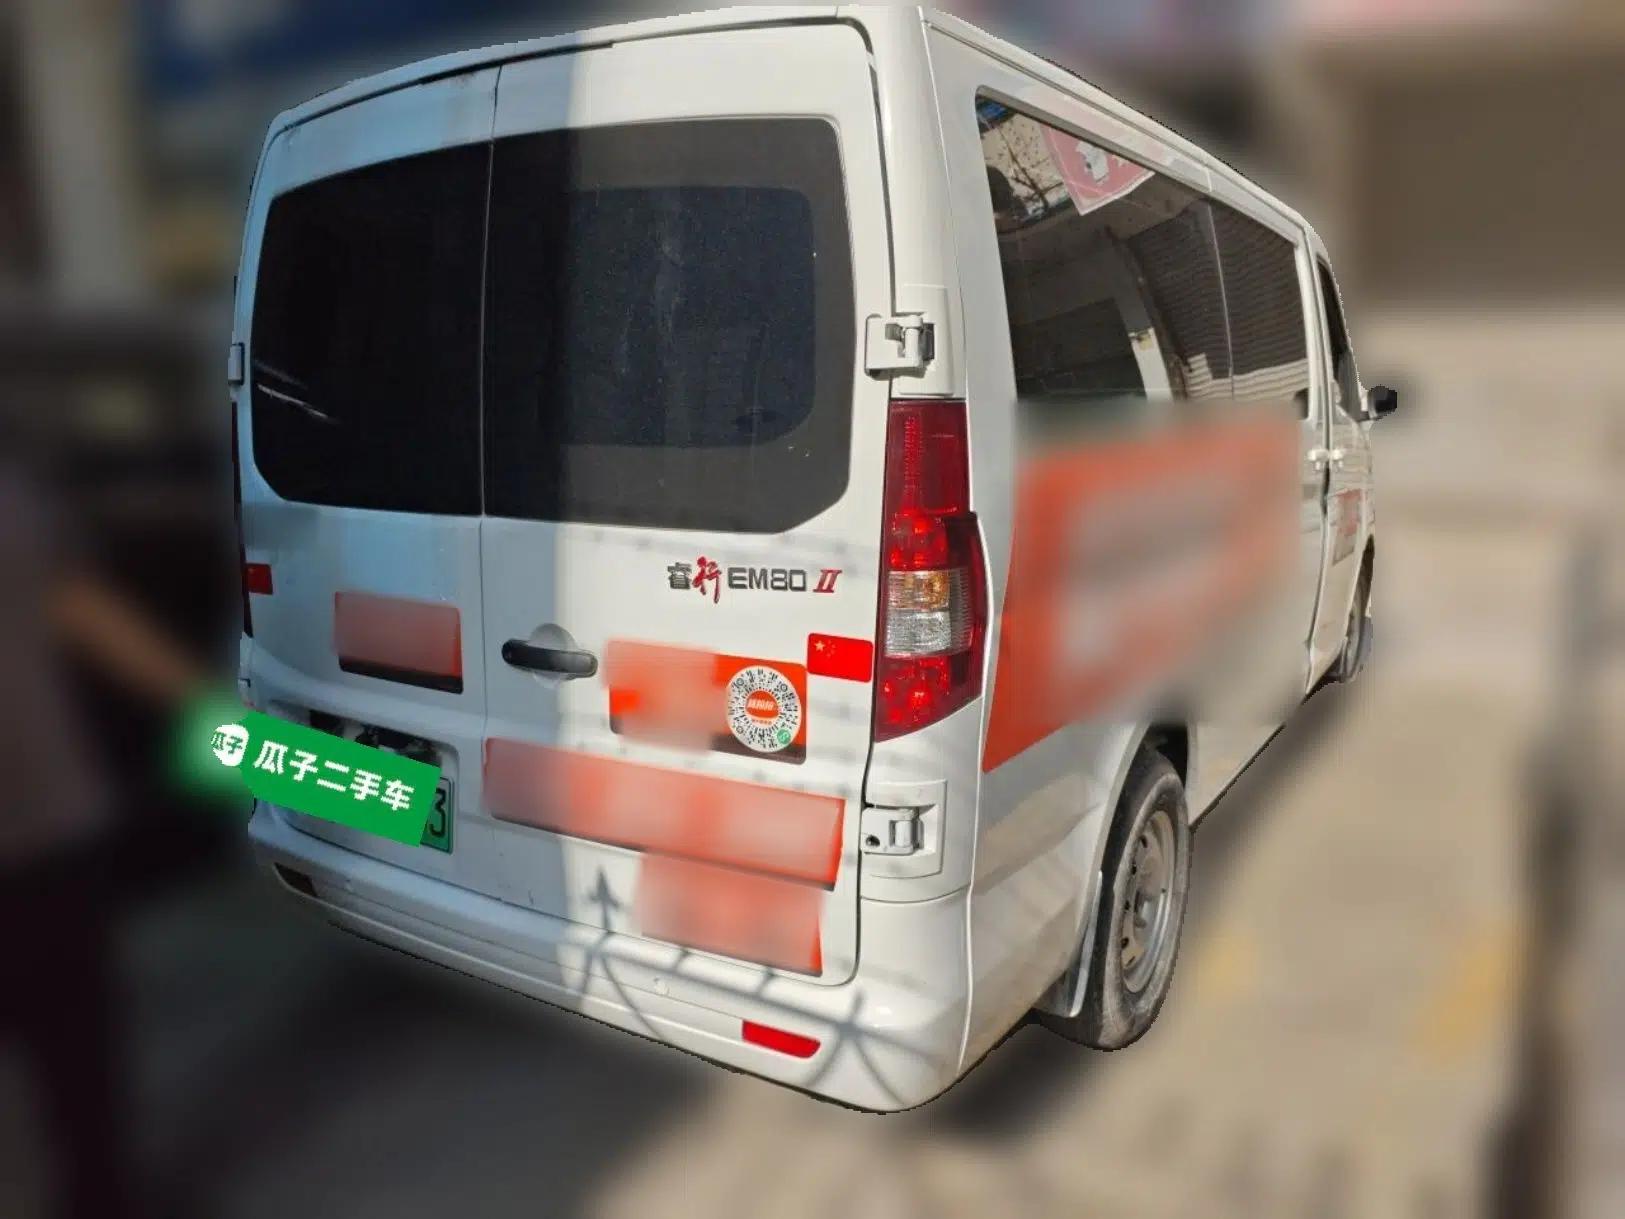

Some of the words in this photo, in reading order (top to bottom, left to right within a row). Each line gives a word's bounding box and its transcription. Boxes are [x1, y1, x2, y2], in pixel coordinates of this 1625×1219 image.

[667, 556, 722, 604] 睿行
[727, 567, 807, 592] EM80
[428, 787, 447, 838] 3
